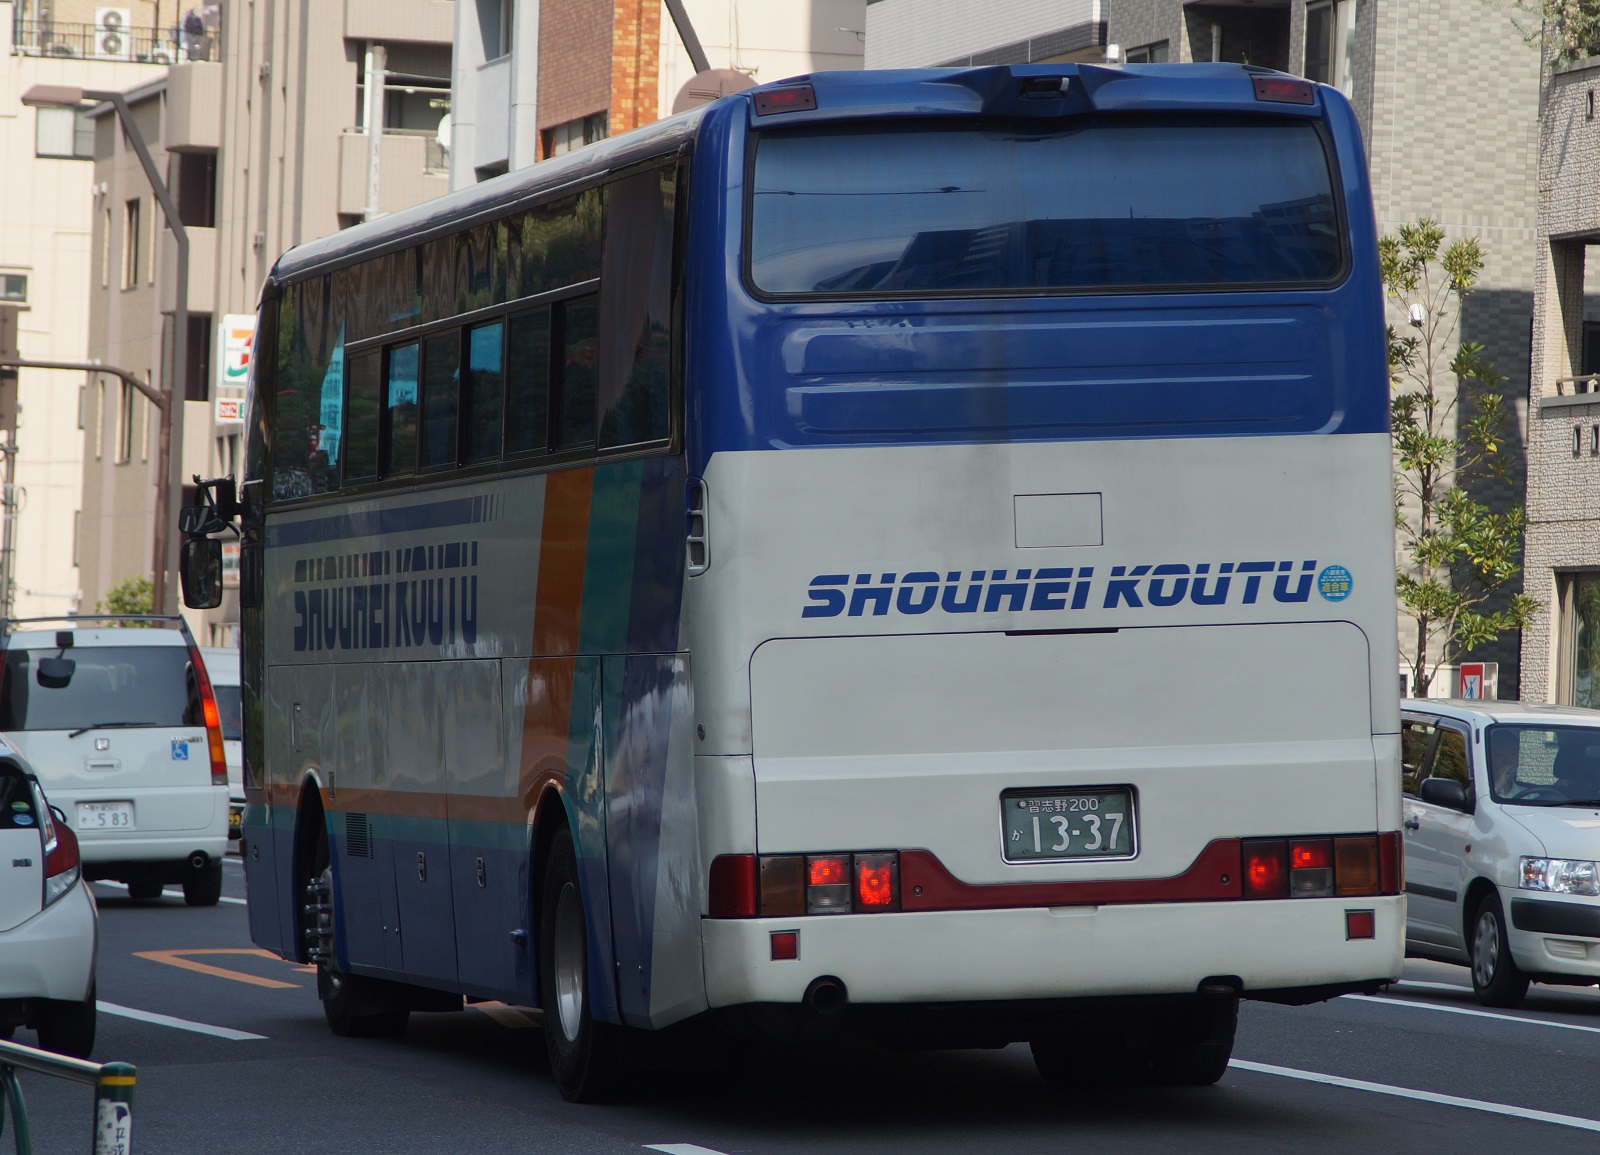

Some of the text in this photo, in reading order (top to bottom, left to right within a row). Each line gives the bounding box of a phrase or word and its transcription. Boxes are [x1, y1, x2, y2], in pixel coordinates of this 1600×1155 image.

[294, 541, 478, 651] SHOUHEI KOUTU
[802, 560, 1318, 618] SHOUHEI KOUTU
[1011, 813, 1124, 853] か 13-37
